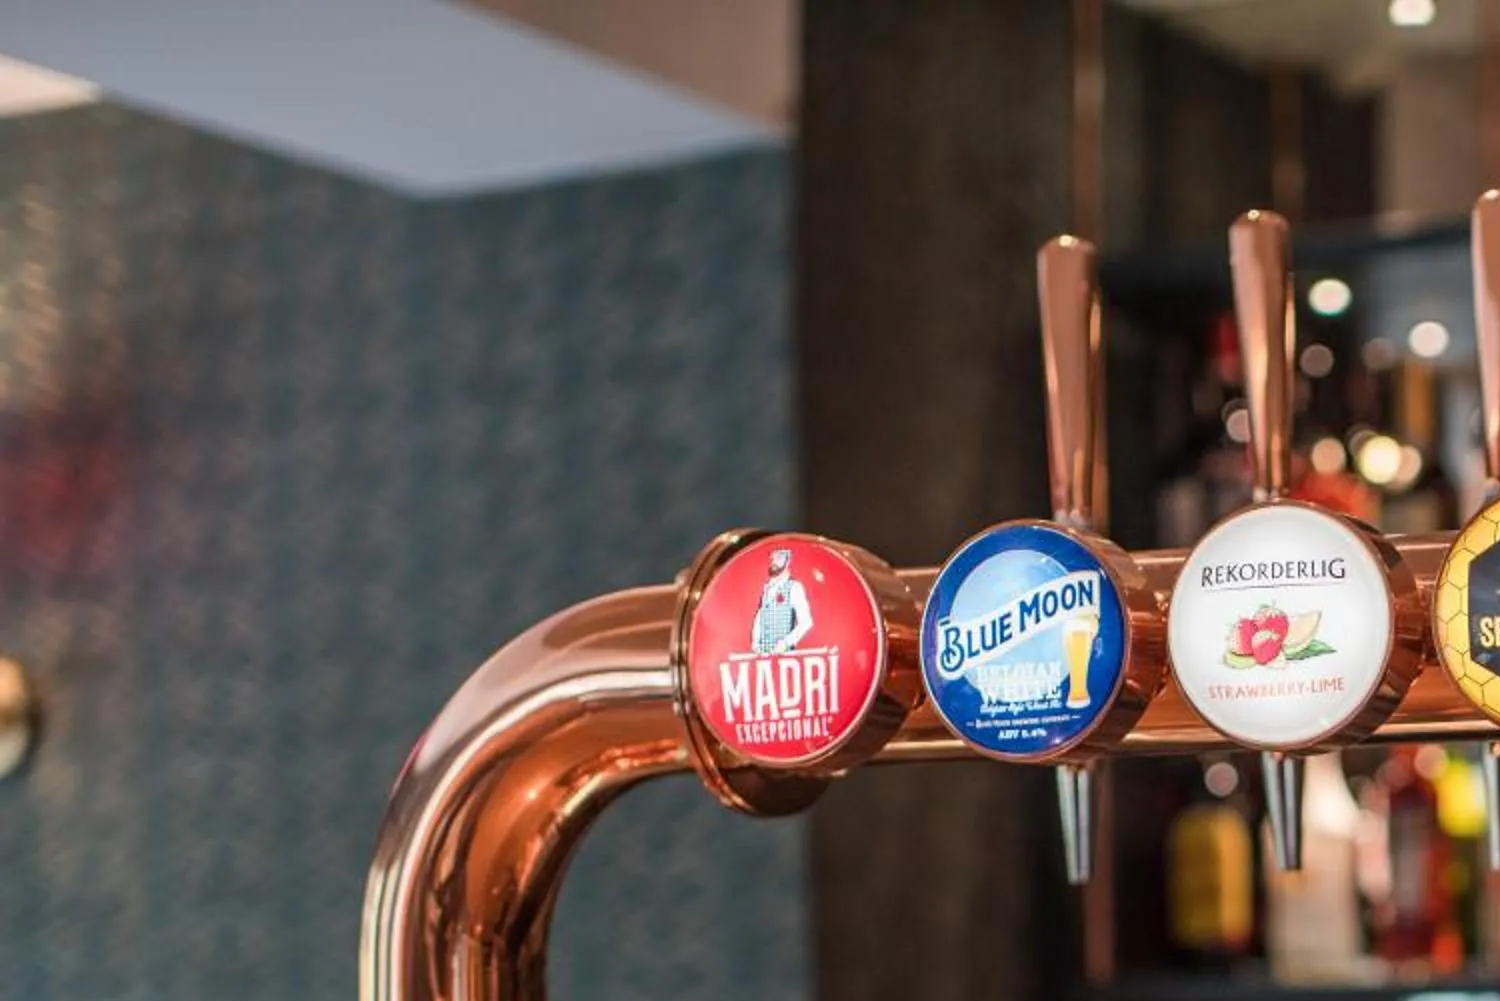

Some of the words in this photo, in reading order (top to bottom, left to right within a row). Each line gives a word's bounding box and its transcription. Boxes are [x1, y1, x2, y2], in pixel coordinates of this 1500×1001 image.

[1201, 557, 1346, 588] REKORDERLIG
[939, 611, 1013, 673] BLUE
[1019, 578, 1095, 633] MOON
[1208, 676, 1345, 700] STRAWBERRY-LIME
[735, 716, 829, 745] EXCEPCIONAL
